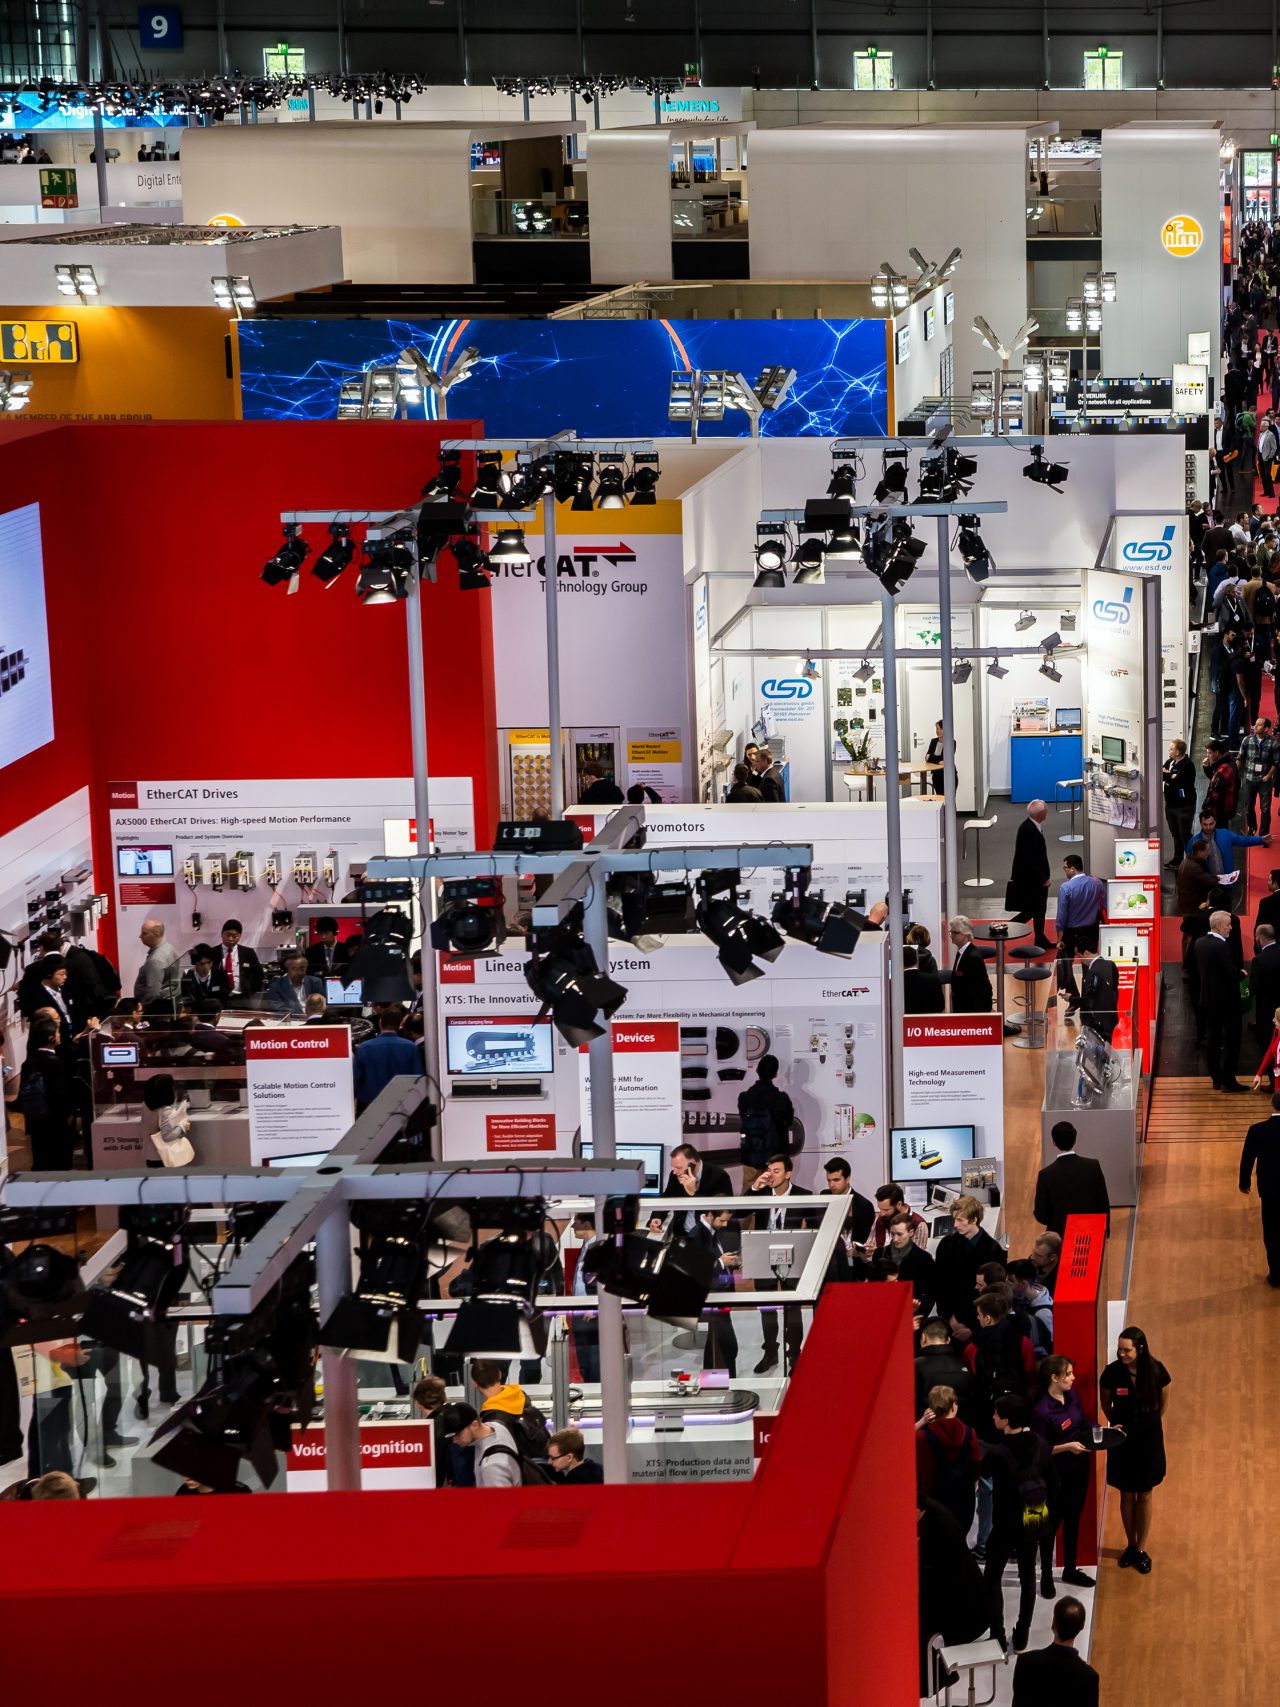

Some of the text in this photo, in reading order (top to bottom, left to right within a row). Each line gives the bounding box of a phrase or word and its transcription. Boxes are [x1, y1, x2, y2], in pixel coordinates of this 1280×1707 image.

[150, 16, 169, 39] 9
[652, 100, 719, 112] IEMENS
[137, 174, 165, 189] Digital
[1175, 387, 1204, 396] SAFETY
[1122, 398, 1151, 406] applications
[539, 580, 648, 595] Tchnology Group
[111, 792, 136, 800] Motion
[146, 788, 239, 800] EtherCAT Drives
[115, 815, 351, 826] AX5000 EtherCAT Drives: High-speed Motion Performance
[644, 822, 705, 833] rvomotors
[443, 963, 471, 971] Motion
[609, 959, 651, 973] ystem
[822, 989, 859, 998] EtherCAT
[445, 994, 541, 1004] XTS: The Innovative
[907, 1026, 993, 1037] I/O Measurement
[616, 1033, 655, 1043] Devices
[250, 1038, 329, 1049] Motion Control
[908, 1069, 939, 1078] High-end
[633, 1075, 643, 1083] for
[252, 1082, 282, 1090] Scalable
[310, 1081, 336, 1089] Control
[619, 1084, 658, 1092] Automation
[292, 1439, 423, 1458] Voic ognition
[645, 1456, 750, 1467] XTS: Production data and
[632, 1467, 750, 1477] material flow in perfect sync
